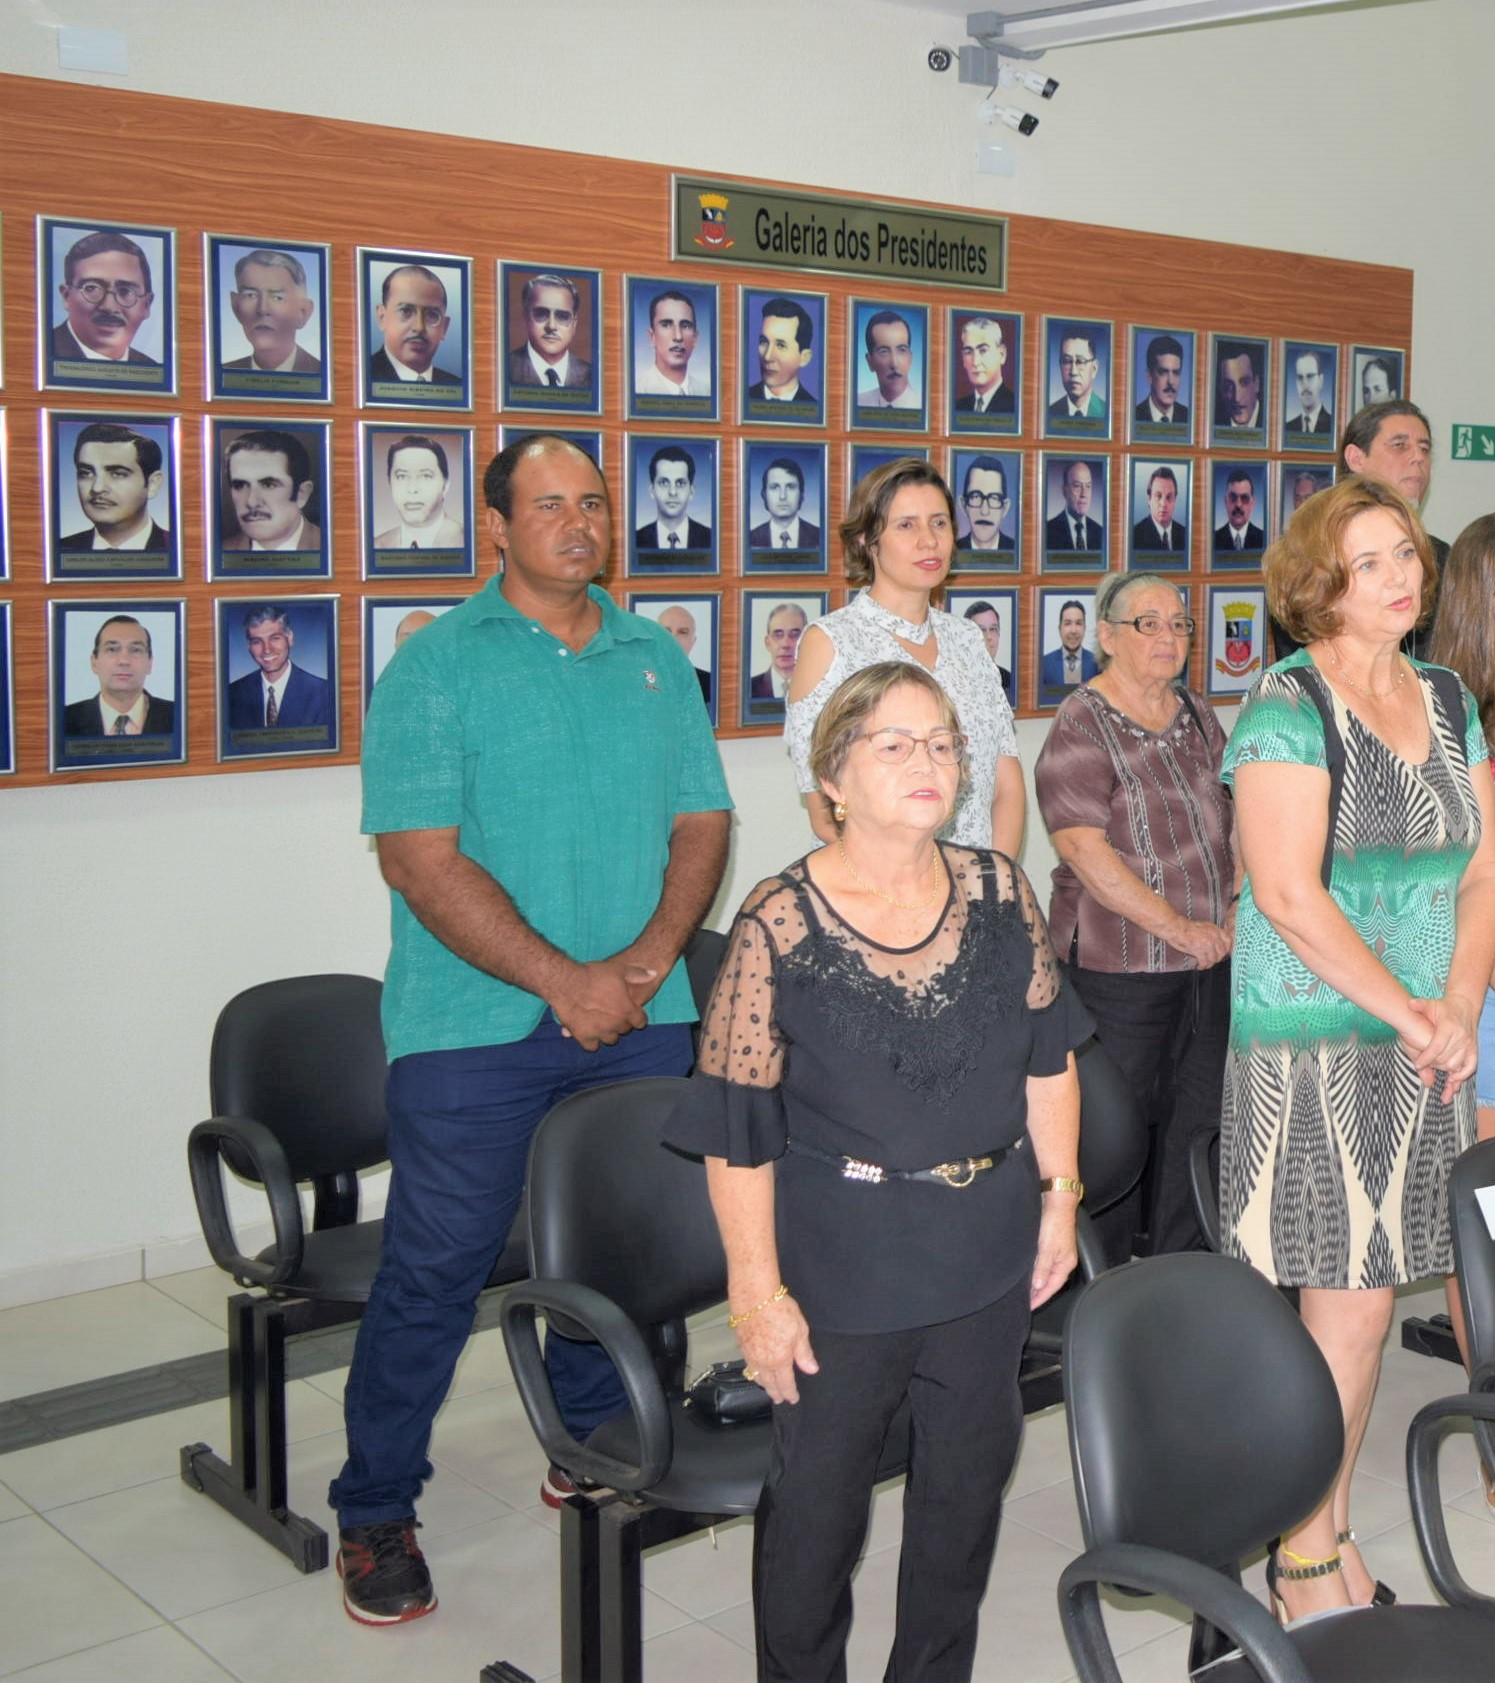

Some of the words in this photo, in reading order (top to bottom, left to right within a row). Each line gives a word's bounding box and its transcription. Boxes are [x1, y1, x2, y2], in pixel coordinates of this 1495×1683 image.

[755, 207, 828, 257] Galeria
[834, 218, 870, 262] dos
[877, 223, 988, 275] Presidentes
